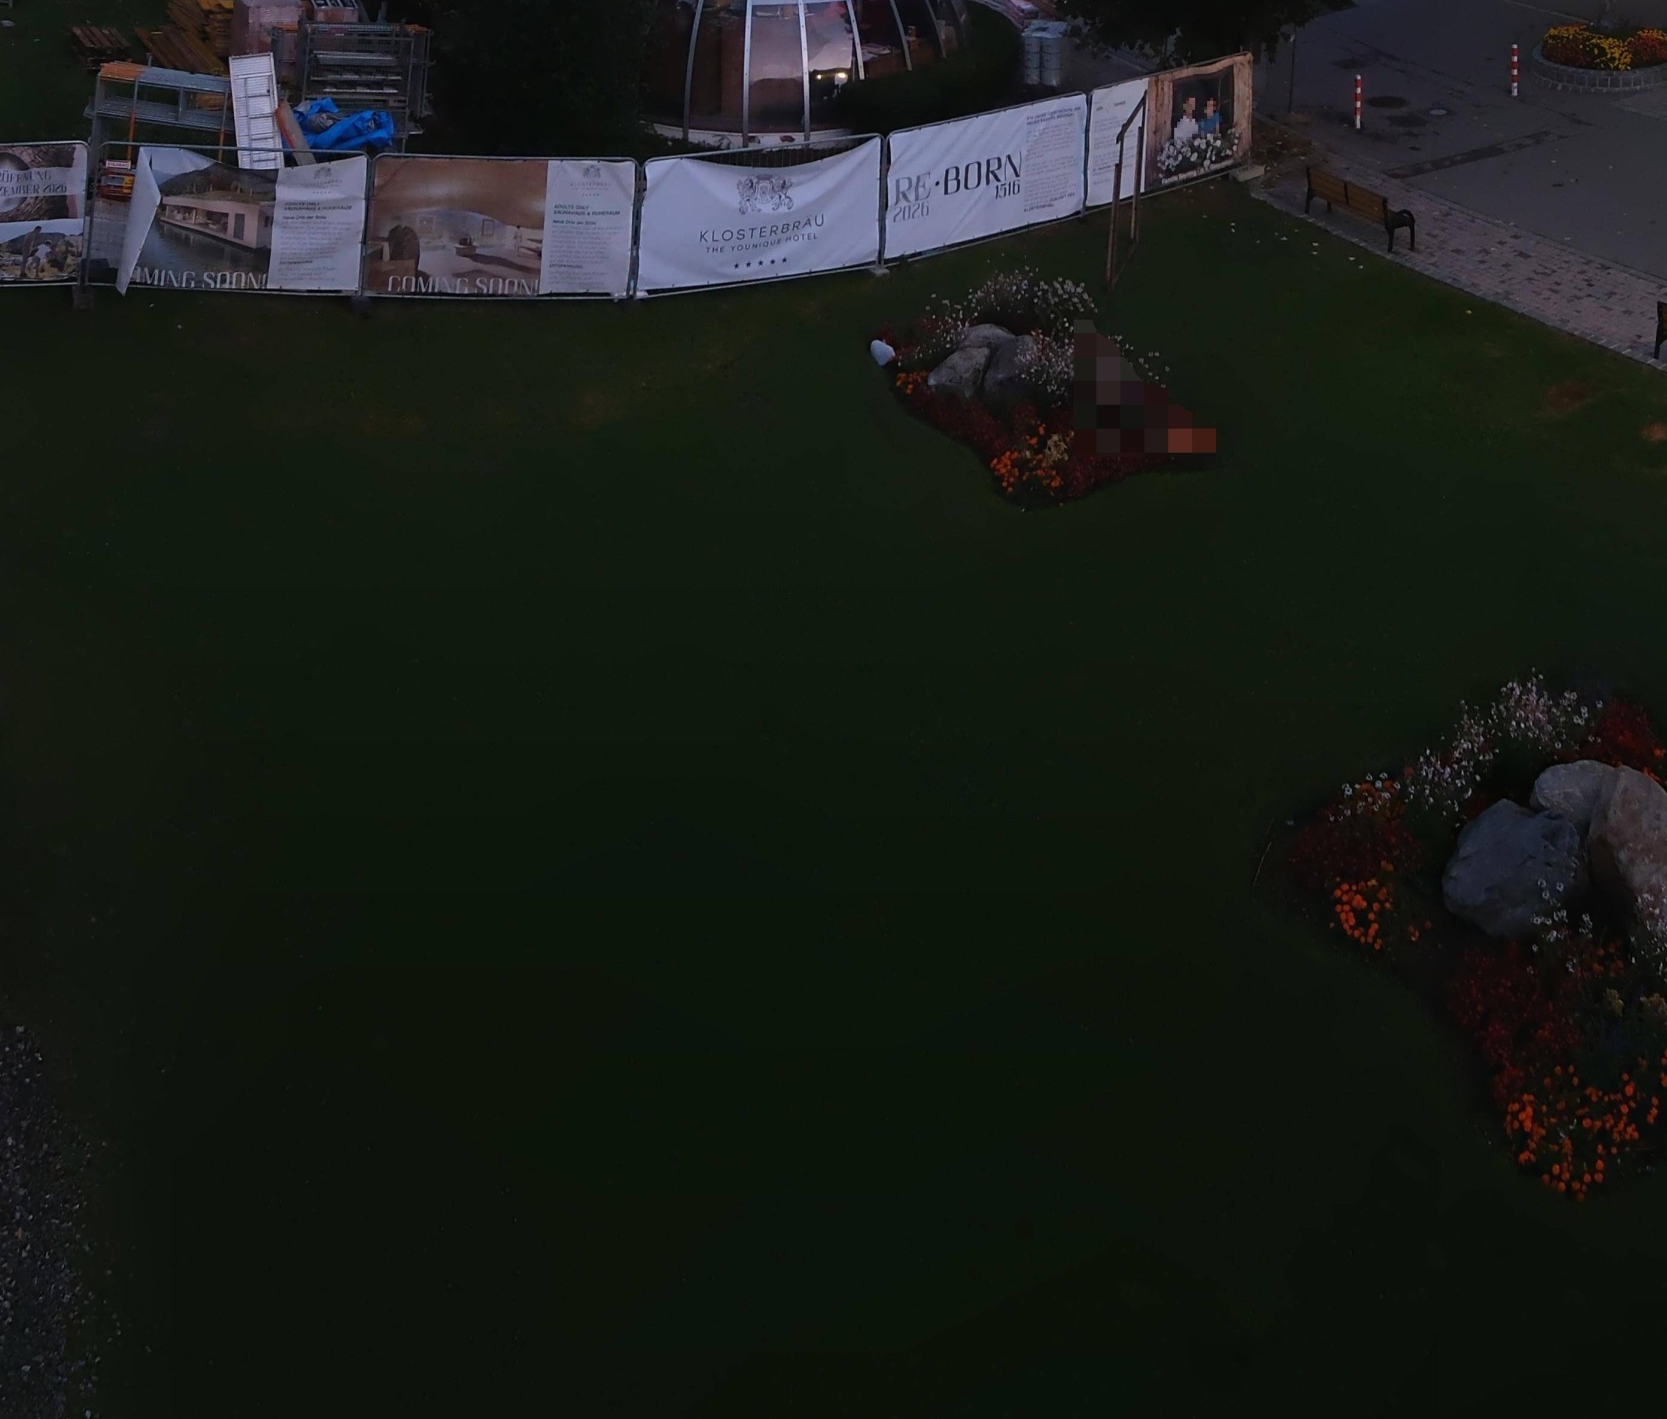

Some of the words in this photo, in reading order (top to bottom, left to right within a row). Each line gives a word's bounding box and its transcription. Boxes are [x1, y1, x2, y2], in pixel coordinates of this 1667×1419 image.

[995, 180, 1021, 200] 1516
[893, 200, 930, 224] 2026
[699, 213, 825, 244] KLOSTERBRÄU
[706, 244, 725, 254] THE
[730, 239, 782, 253] YOUNIQUE
[785, 233, 819, 245] HOTEL
